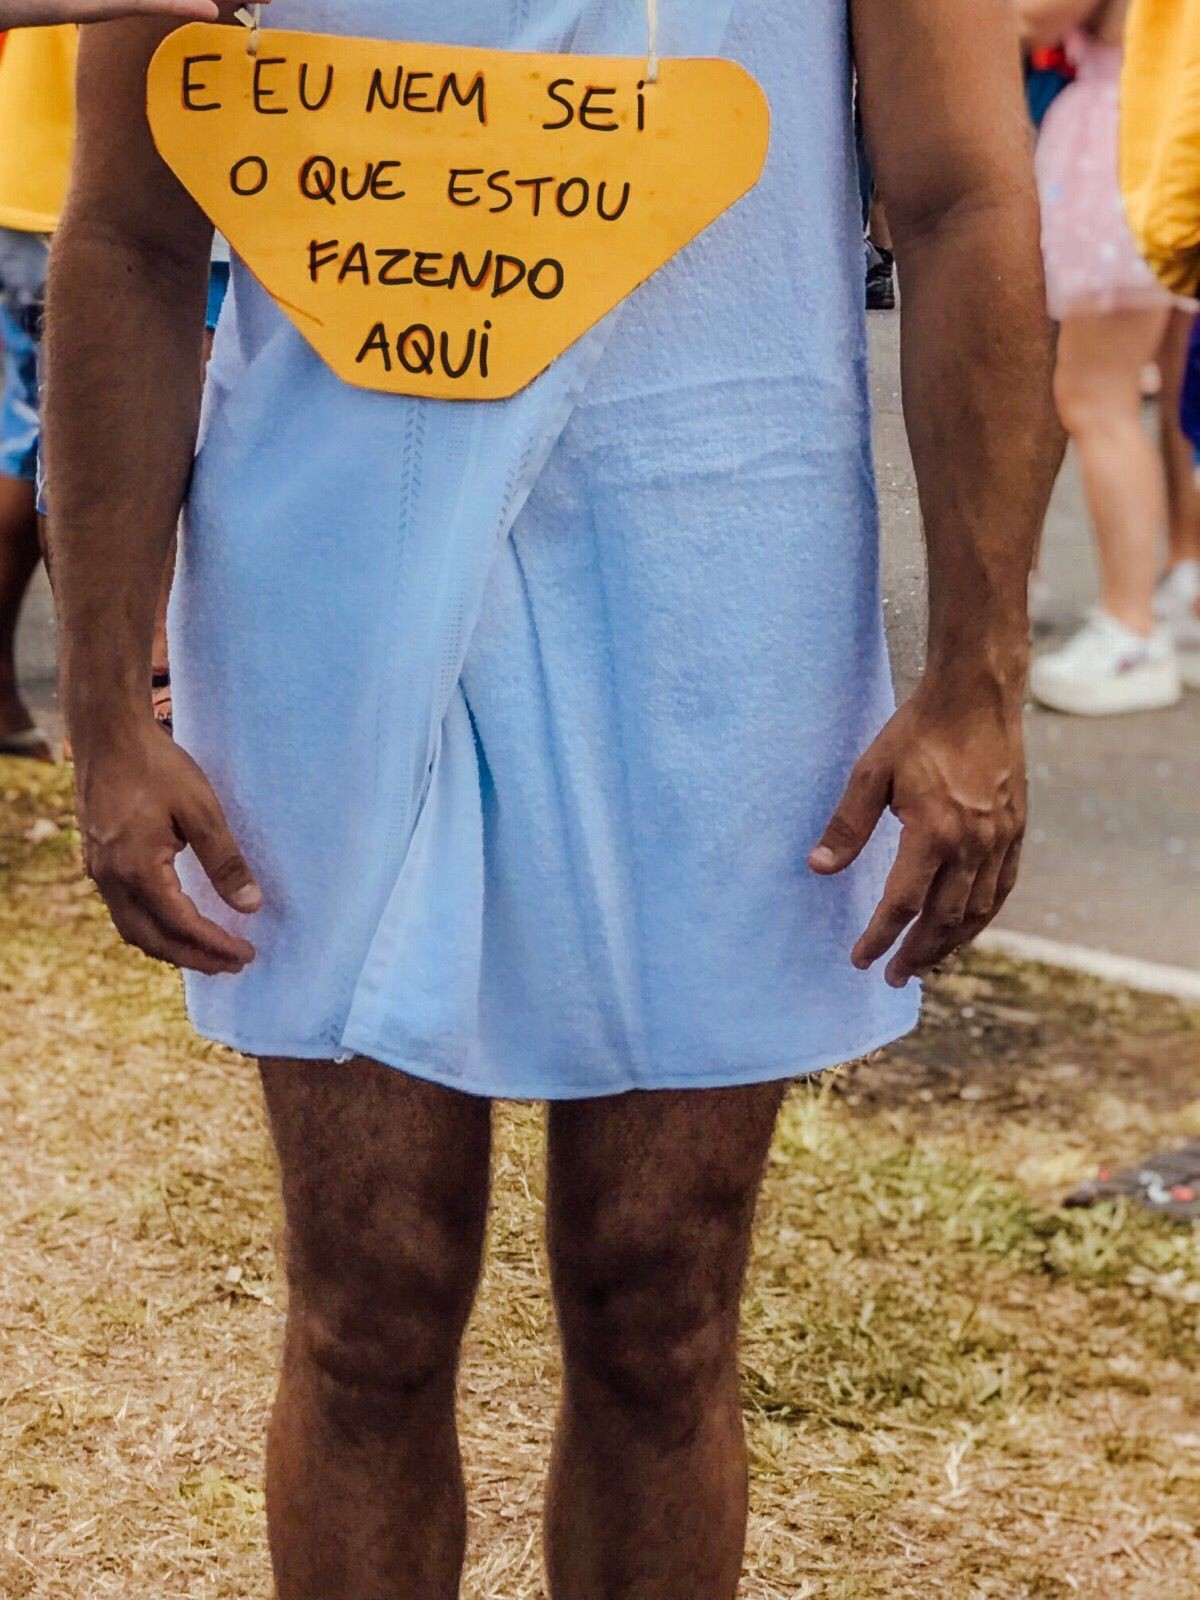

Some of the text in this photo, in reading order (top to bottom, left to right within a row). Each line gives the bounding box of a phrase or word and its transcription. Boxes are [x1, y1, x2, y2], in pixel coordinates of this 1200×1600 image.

[181, 53, 223, 113] E
[252, 56, 335, 116] EU
[364, 64, 489, 127] NEM
[228, 154, 632, 223] O QUE ESTOU
[307, 238, 566, 301] FAZENDO
